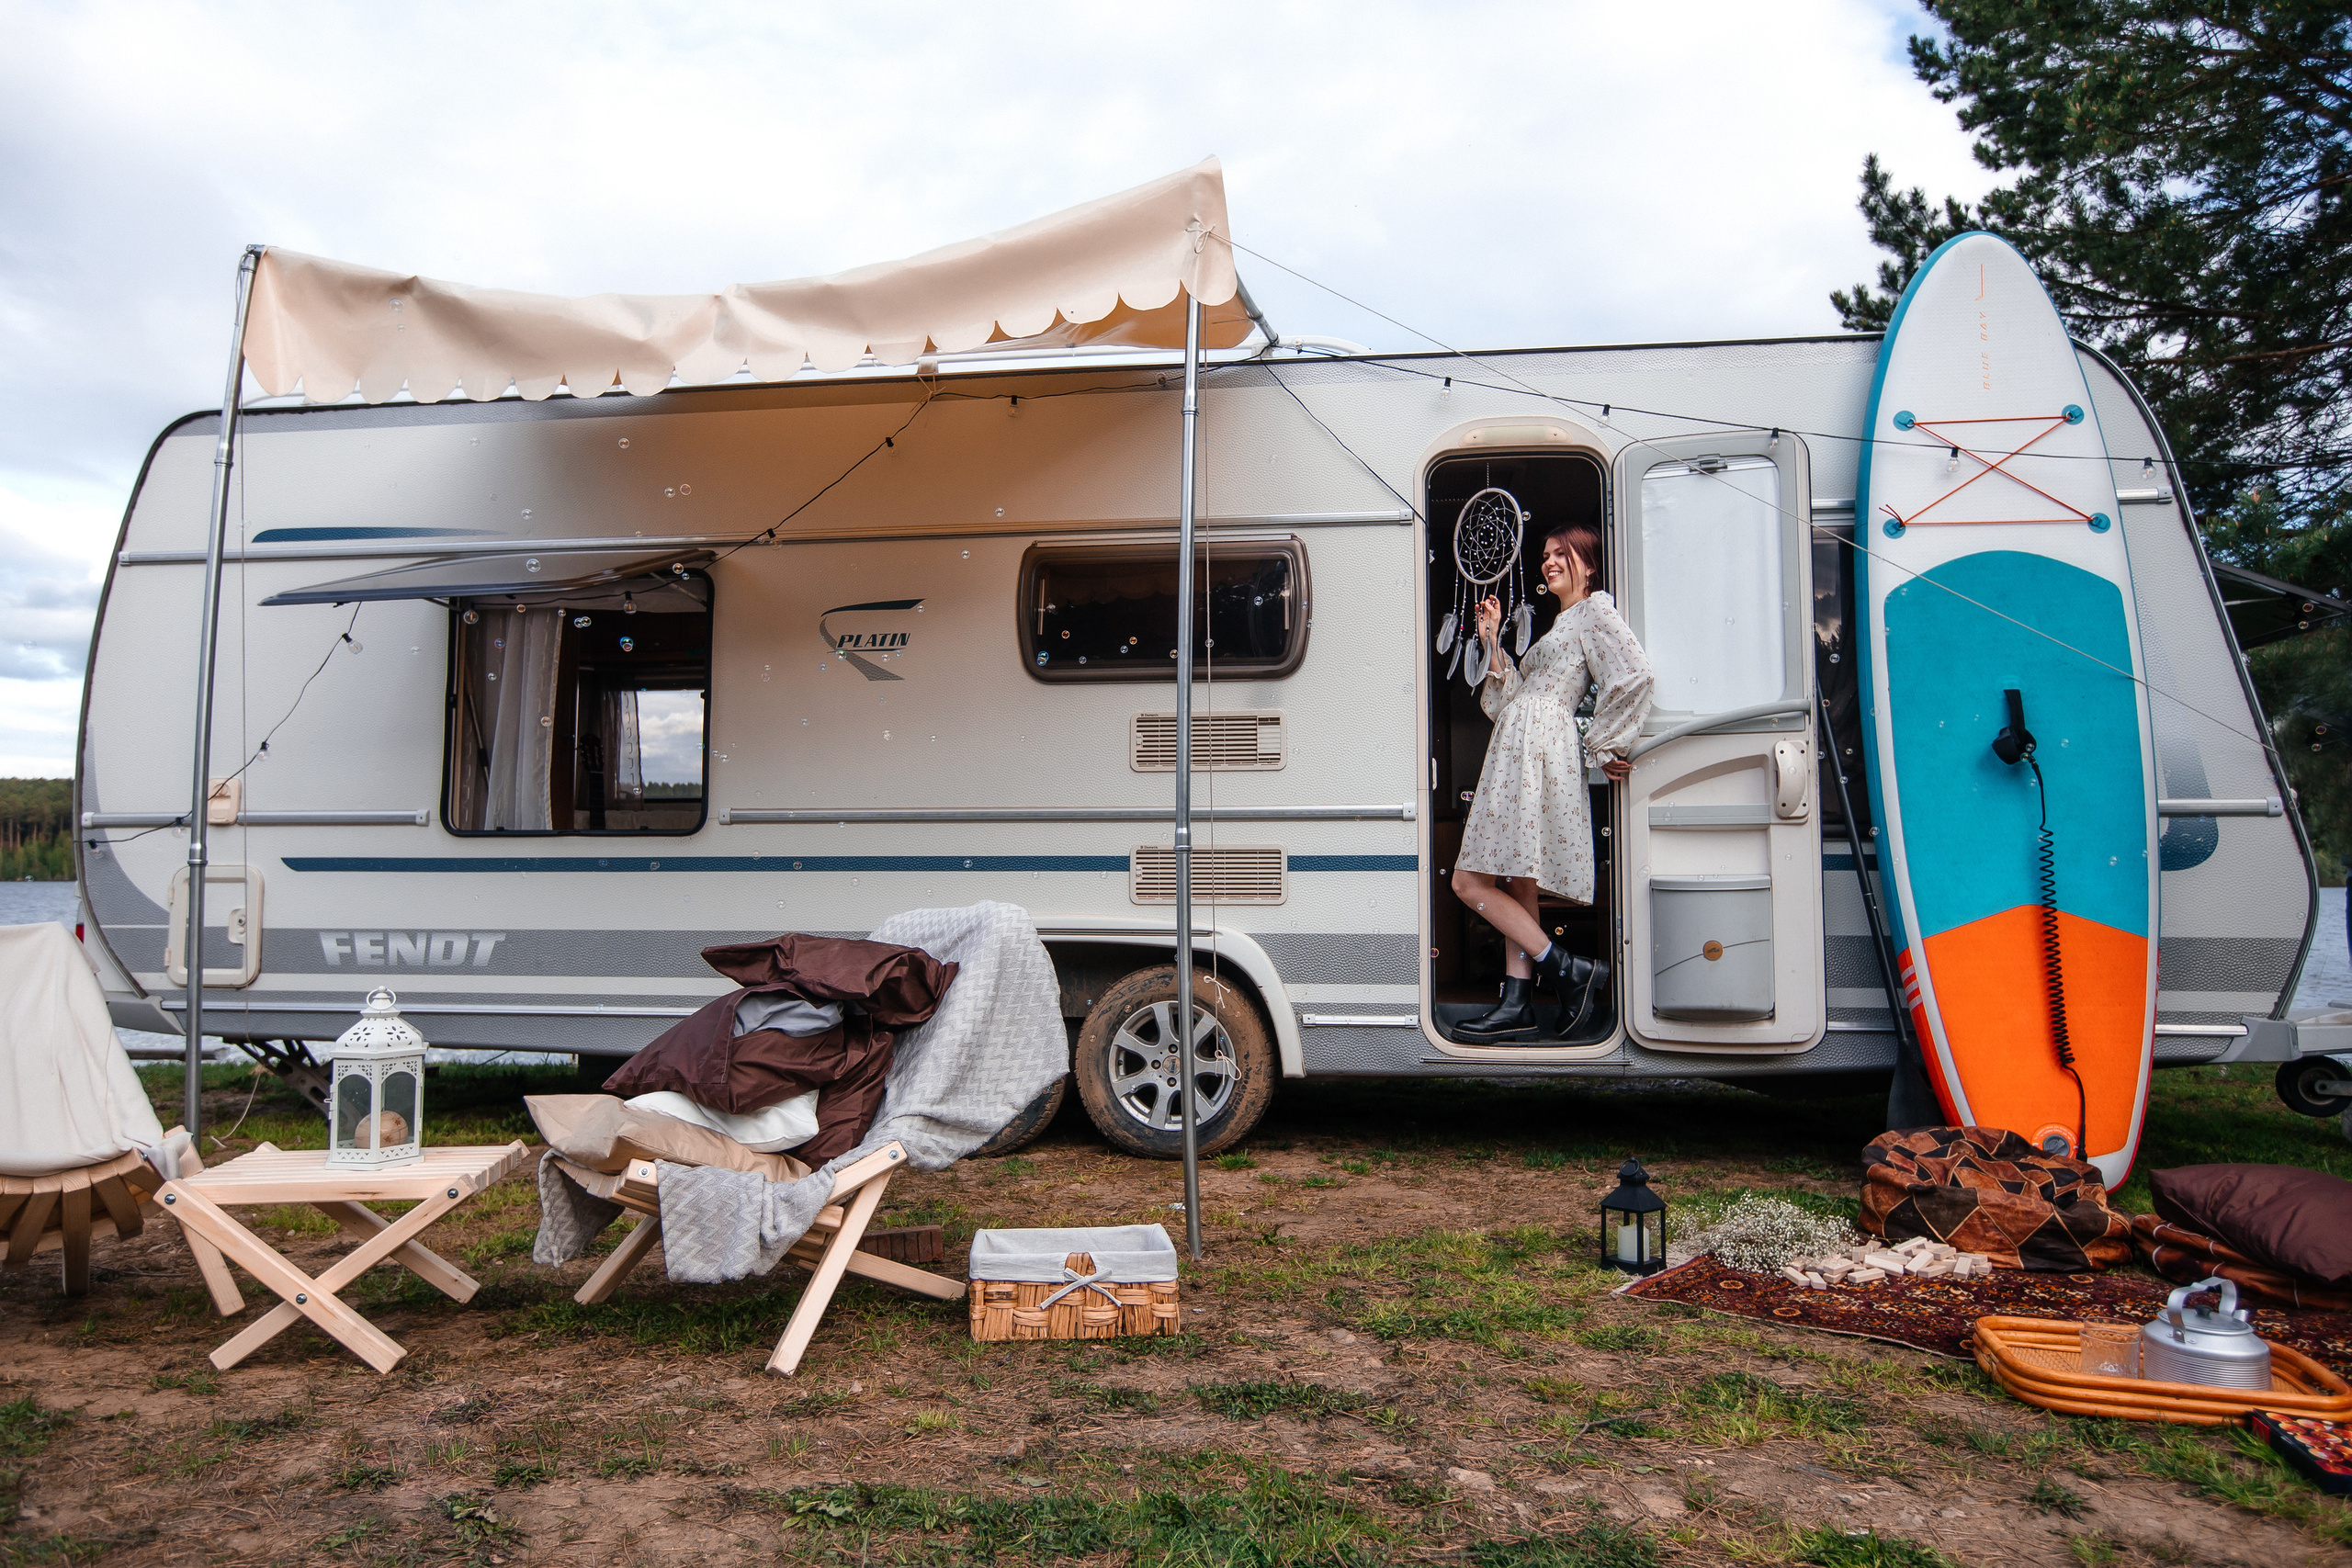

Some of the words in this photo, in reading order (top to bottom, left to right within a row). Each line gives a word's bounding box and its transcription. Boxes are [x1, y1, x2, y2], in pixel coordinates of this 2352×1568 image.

[1980, 311, 1988, 341] BAY
[1982, 352, 1991, 390] BLUE
[837, 633, 911, 649] PLATIN
[320, 931, 506, 964] FENDT
